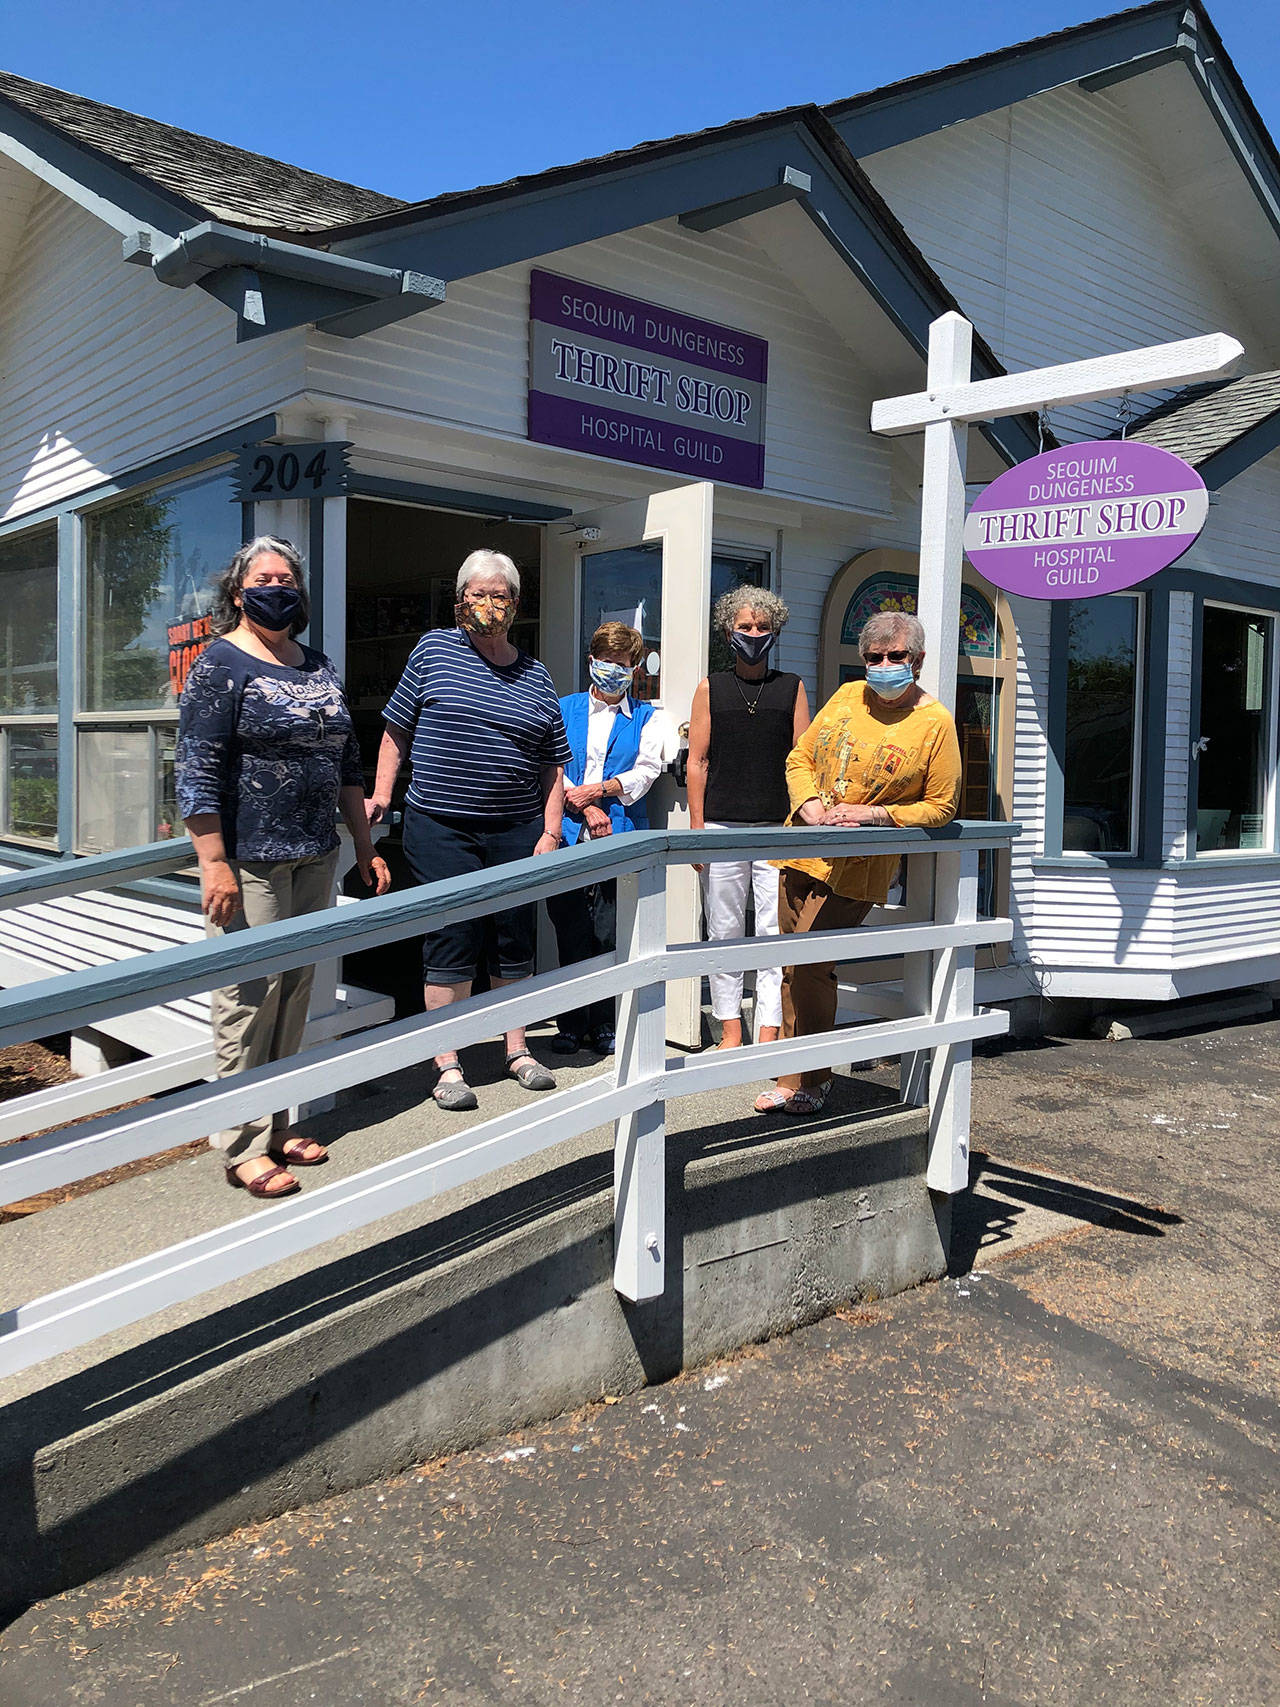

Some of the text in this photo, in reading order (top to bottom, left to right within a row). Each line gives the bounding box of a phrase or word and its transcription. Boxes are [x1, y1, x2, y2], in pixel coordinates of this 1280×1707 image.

[561, 295, 745, 366] SEQUIM DUNGENESS
[551, 337, 751, 426] THRIFT SHOP
[581, 415, 723, 464] HOSPITAL GUILD
[252, 450, 327, 493] 204
[1028, 474, 1135, 501] DUNGENESS
[1046, 456, 1117, 480] SEQUIM
[979, 497, 1187, 545] THRIFT SHOP
[1033, 546, 1116, 568] HOSPITAL
[1046, 566, 1099, 586] GUILD
